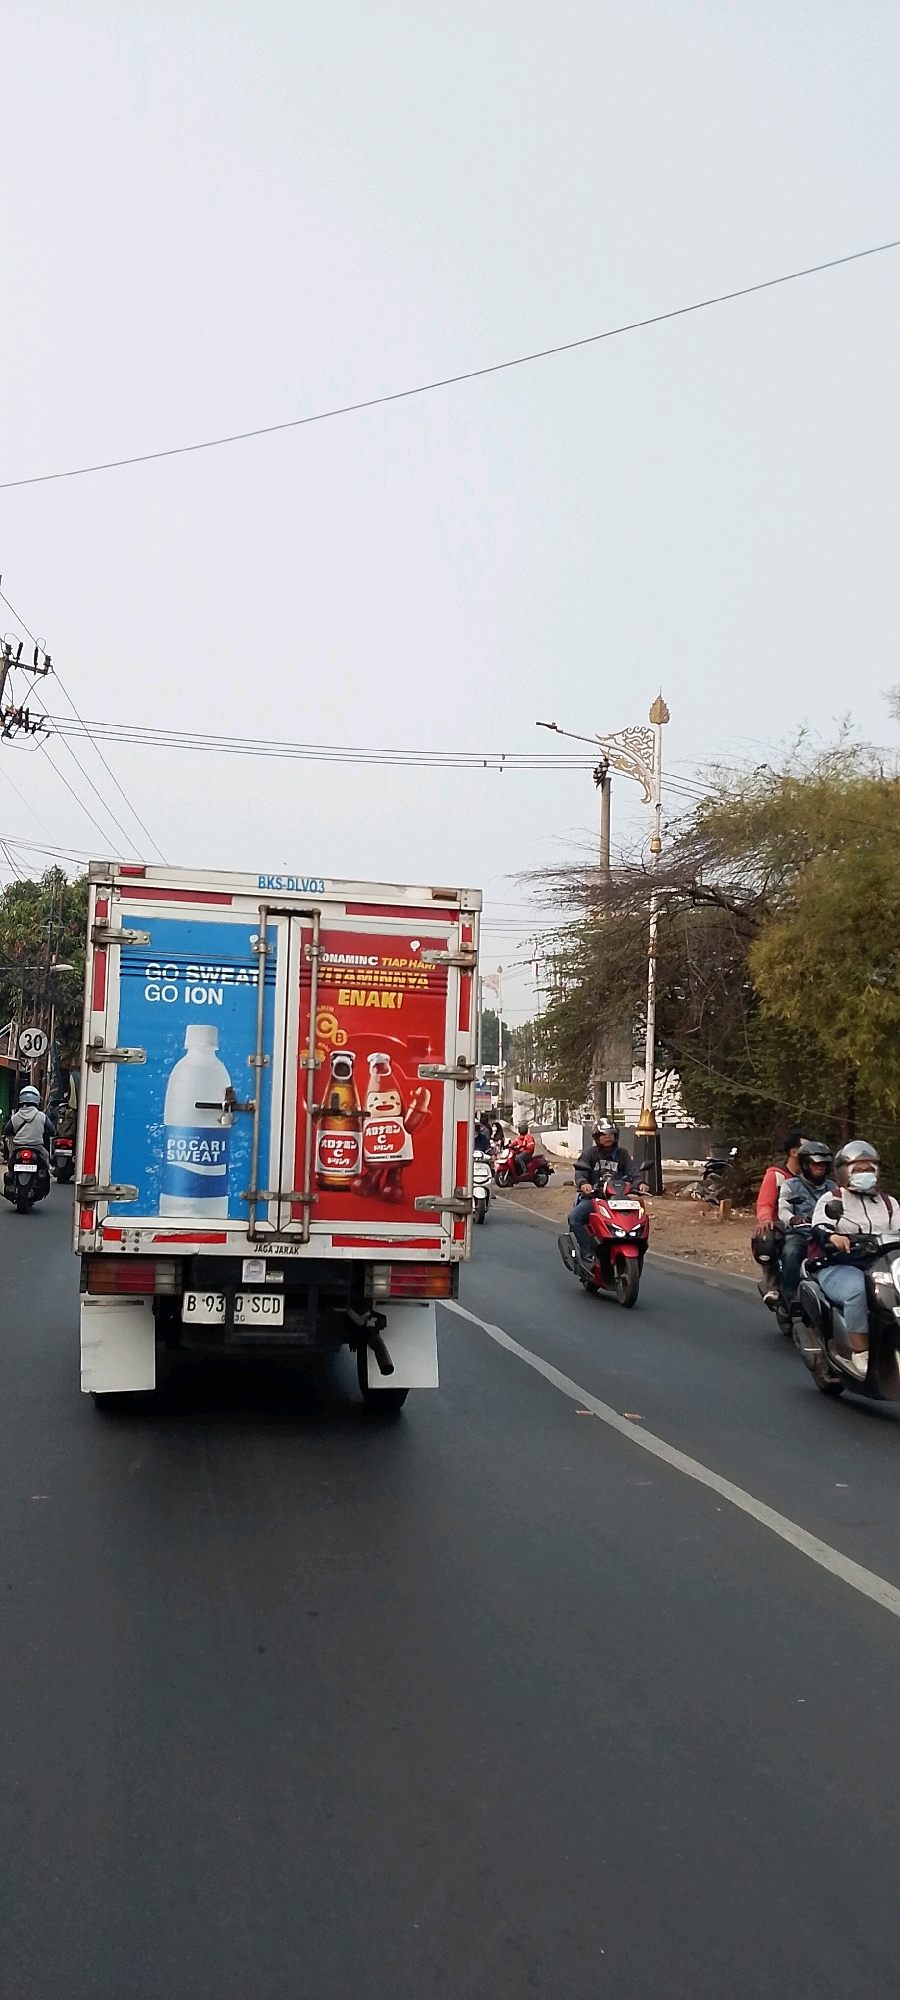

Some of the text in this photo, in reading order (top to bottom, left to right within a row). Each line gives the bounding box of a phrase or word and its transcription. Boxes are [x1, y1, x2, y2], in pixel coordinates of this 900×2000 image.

[381, 957, 408, 967] TIAP
[145, 962, 179, 982] GO
[144, 984, 224, 1005] GO ION
[338, 988, 404, 1009] ENAK!
[24, 1033, 43, 1051] 30
[365, 1124, 401, 1136] オロナミン
[167, 1138, 226, 1151] POCARI
[320, 1139, 357, 1150] オロナミン
[377, 1135, 387, 1144] C
[166, 1149, 220, 1162] SWEAT
[333, 1149, 344, 1158] C
[253, 1244, 300, 1256] JAGA JARAK
[187, 1294, 281, 1314] B 930 SCD
